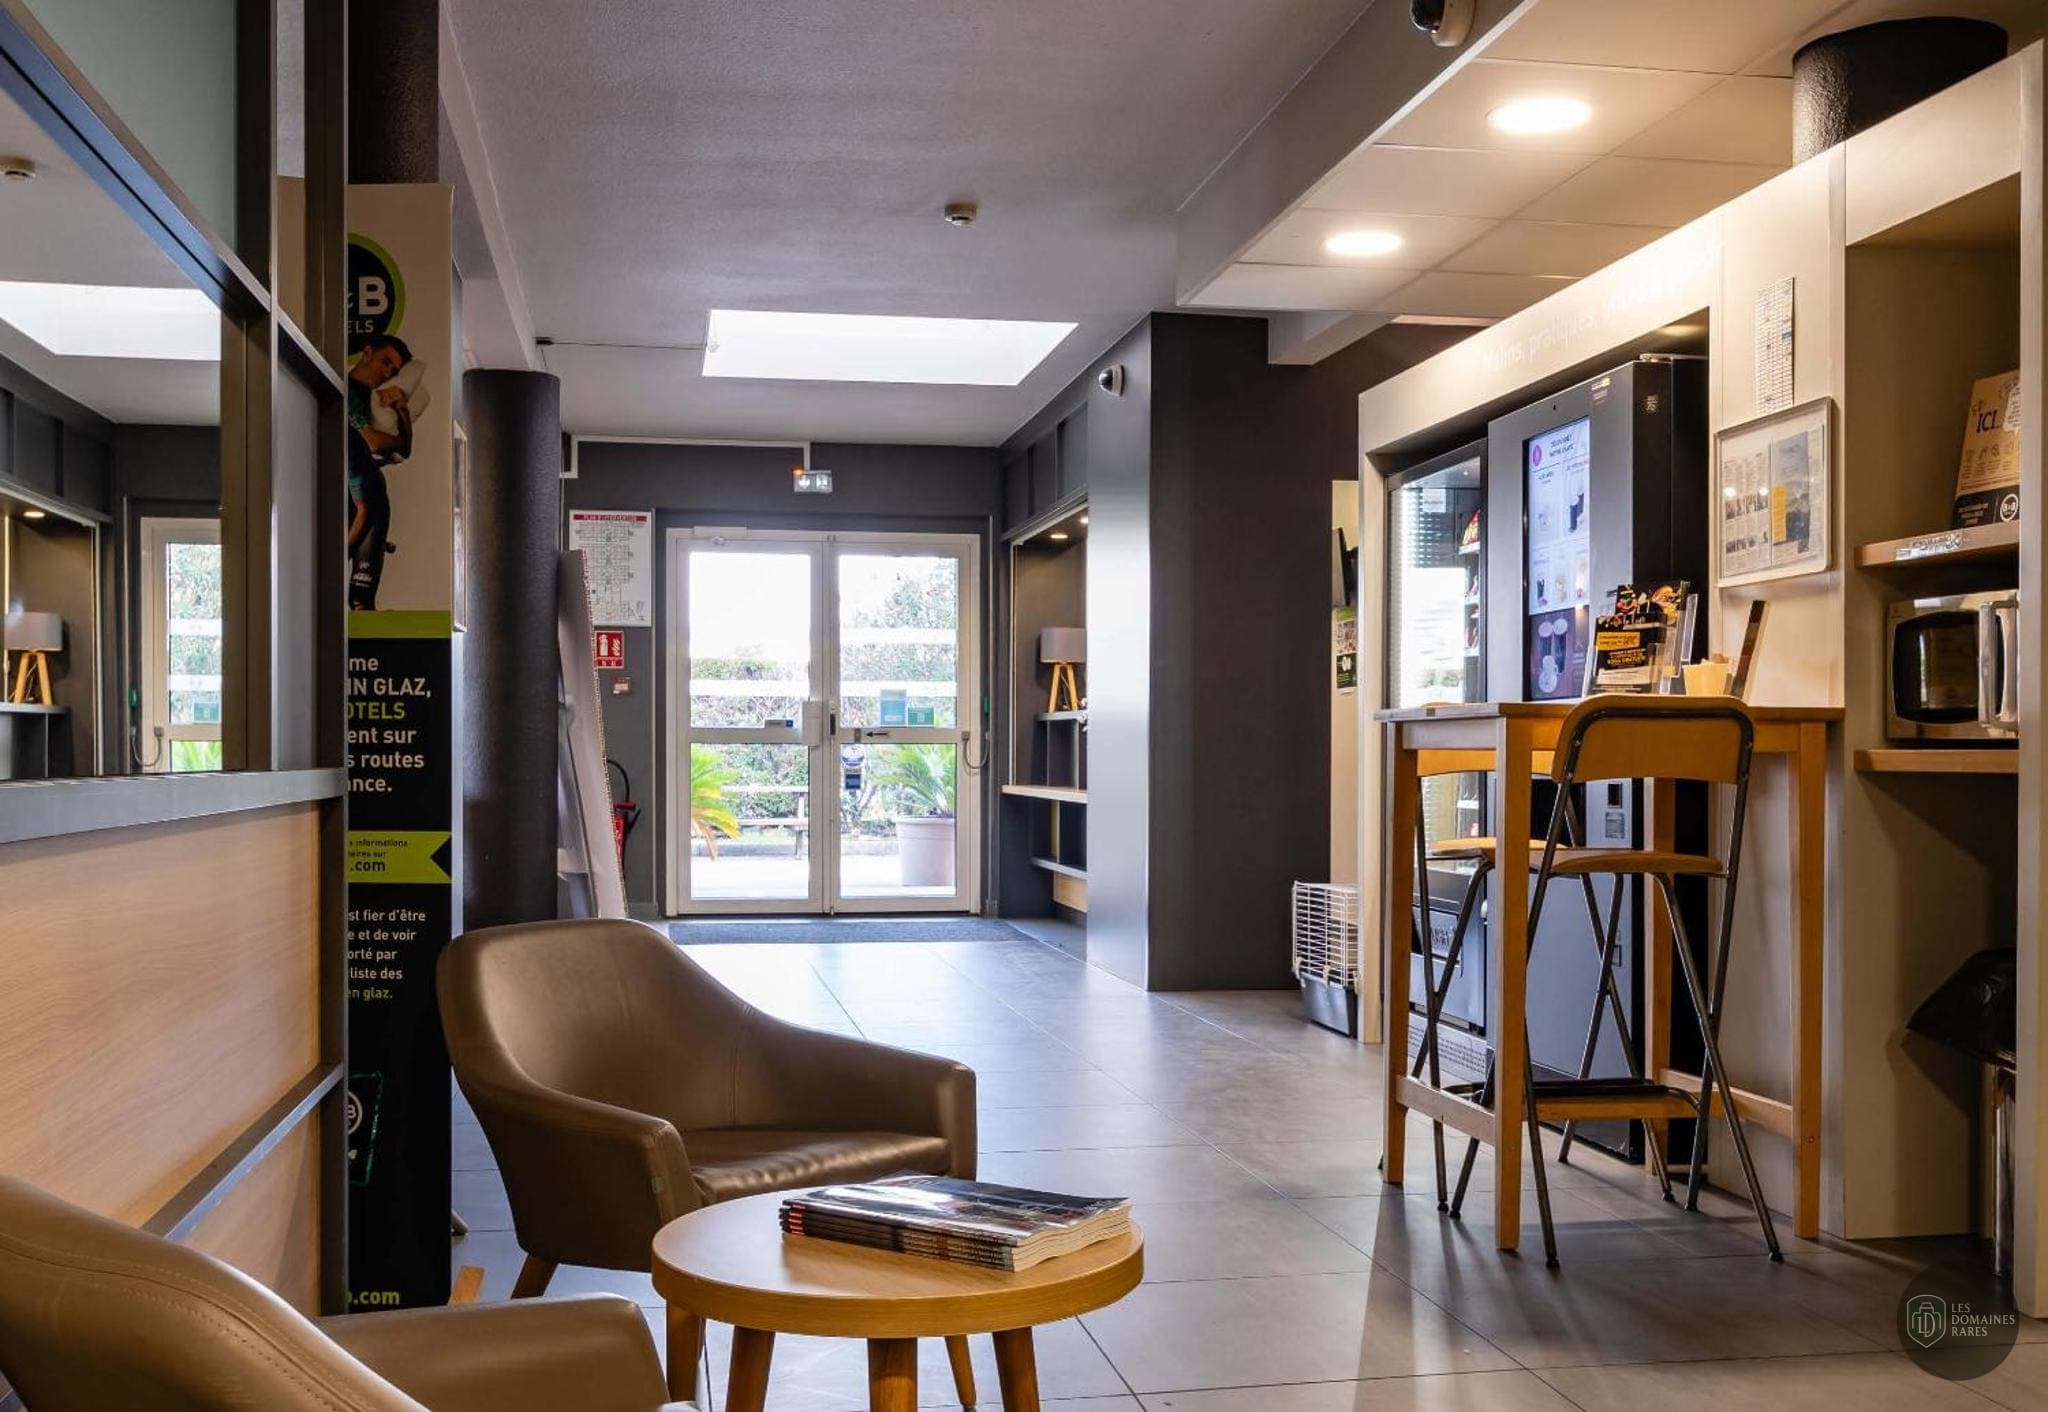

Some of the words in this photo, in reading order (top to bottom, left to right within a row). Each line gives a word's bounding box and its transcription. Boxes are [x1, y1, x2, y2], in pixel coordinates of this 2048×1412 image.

[373, 677, 432, 698] GLAZ,
[348, 727, 378, 744] ent
[383, 730, 417, 744] sur
[361, 751, 424, 768] routes
[350, 860, 386, 872] .com
[348, 910, 359, 921] st
[363, 909, 385, 921] fier
[388, 909, 426, 921] d'être
[358, 930, 370, 940] et
[374, 929, 389, 940] de
[392, 929, 416, 941] voir
[376, 950, 398, 963] par
[350, 967, 377, 979] liste
[380, 967, 403, 979] des
[363, 987, 393, 1001] glaz.
